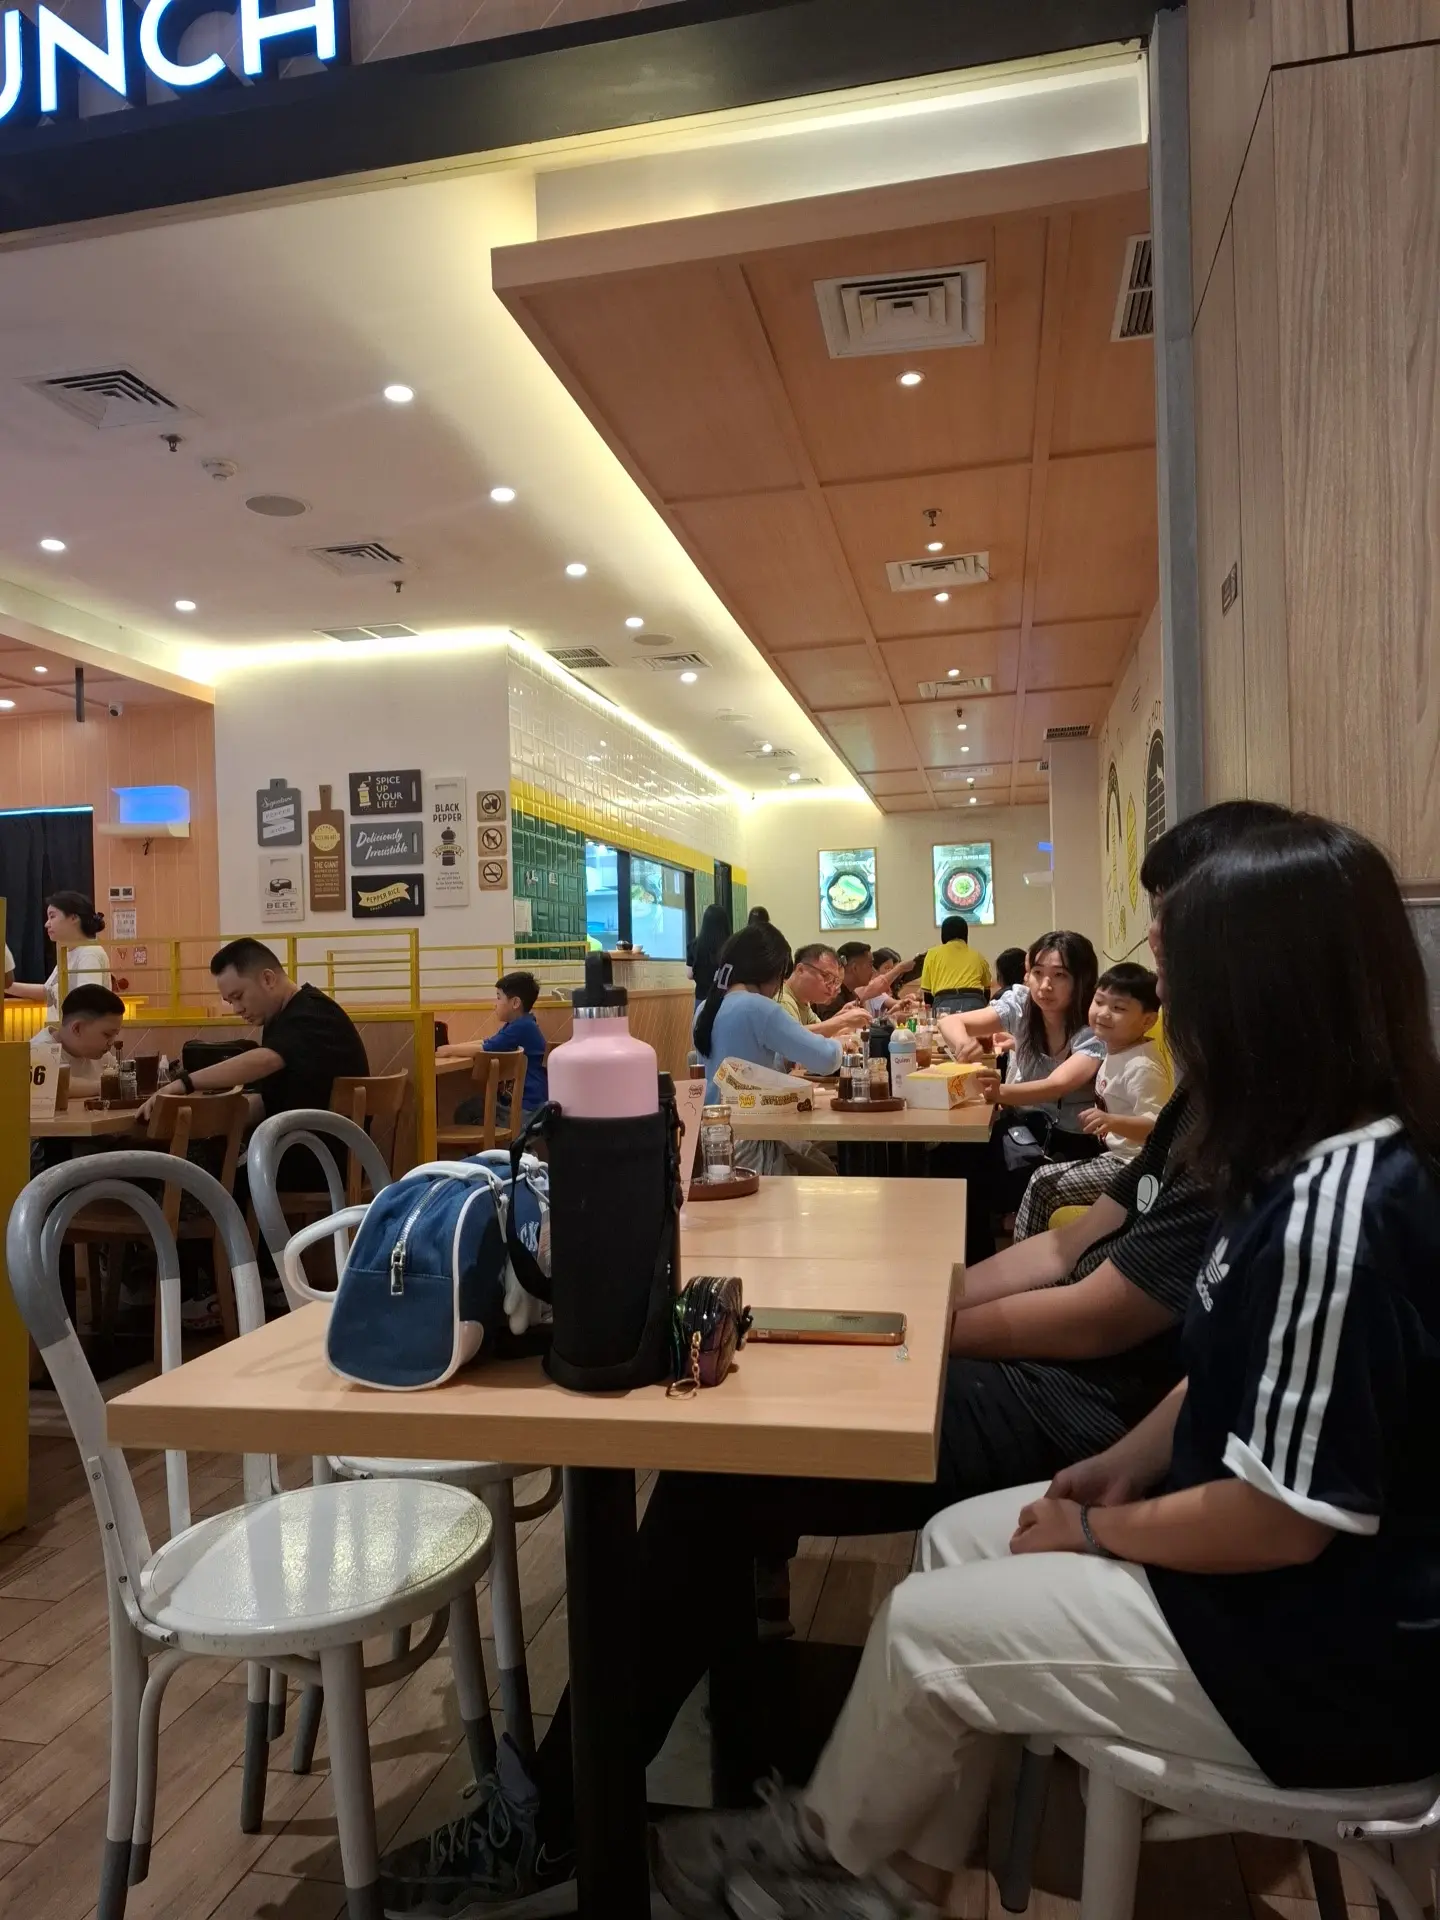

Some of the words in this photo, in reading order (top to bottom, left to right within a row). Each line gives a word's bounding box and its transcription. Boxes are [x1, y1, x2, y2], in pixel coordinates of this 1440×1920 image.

[375, 776, 401, 785] SPICE
[376, 785, 388, 793] UP
[376, 792, 403, 801] YOUR
[376, 800, 397, 809] LIFE!
[435, 803, 459, 813] BLACK
[433, 812, 462, 823] PEPPER
[356, 828, 403, 848] Deliciously
[365, 842, 408, 860] Irresistible
[314, 861, 323, 869] THE
[323, 860, 338, 869] GIANT
[366, 893, 387, 904] PEPPER
[387, 887, 401, 897] RICE
[266, 901, 297, 909] BEEF
[30, 1065, 46, 1086] 6
